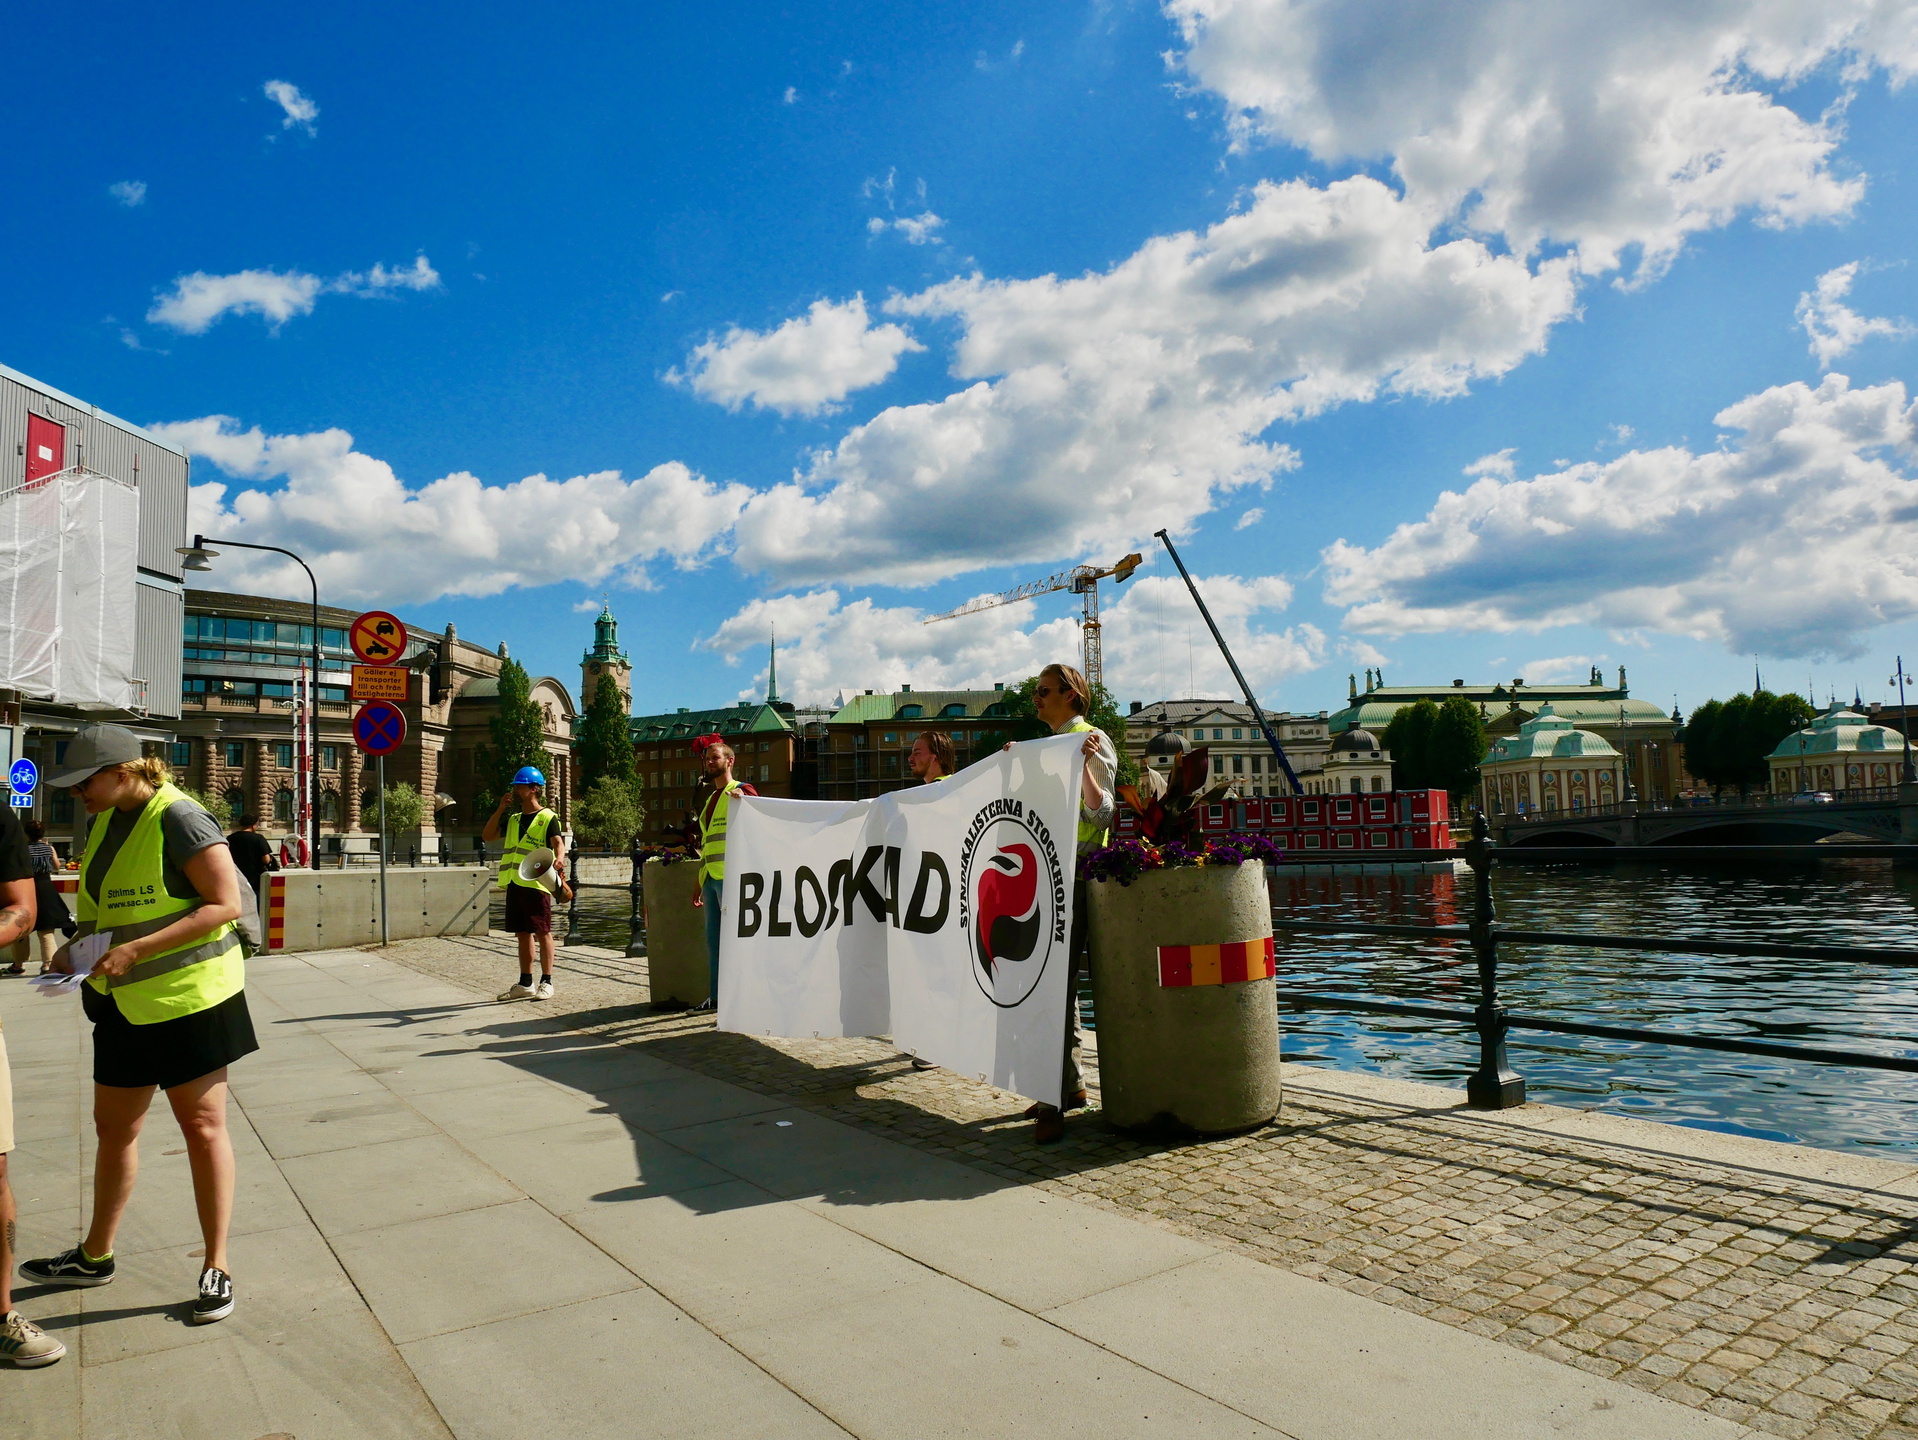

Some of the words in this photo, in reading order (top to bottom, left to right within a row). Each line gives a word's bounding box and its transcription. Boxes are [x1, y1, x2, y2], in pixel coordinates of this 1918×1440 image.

[363, 668, 387, 676] Gäller
[389, 669, 397, 677] ej
[358, 676, 402, 684] transporter
[354, 690, 405, 698] fastigheterna
[959, 798, 1023, 929] SYNDIKALISTERNA
[1026, 809, 1065, 944] STOCKHOLM
[107, 888, 136, 899] Sthlms
[139, 885, 155, 895] LS
[107, 898, 156, 910] www.sac.se
